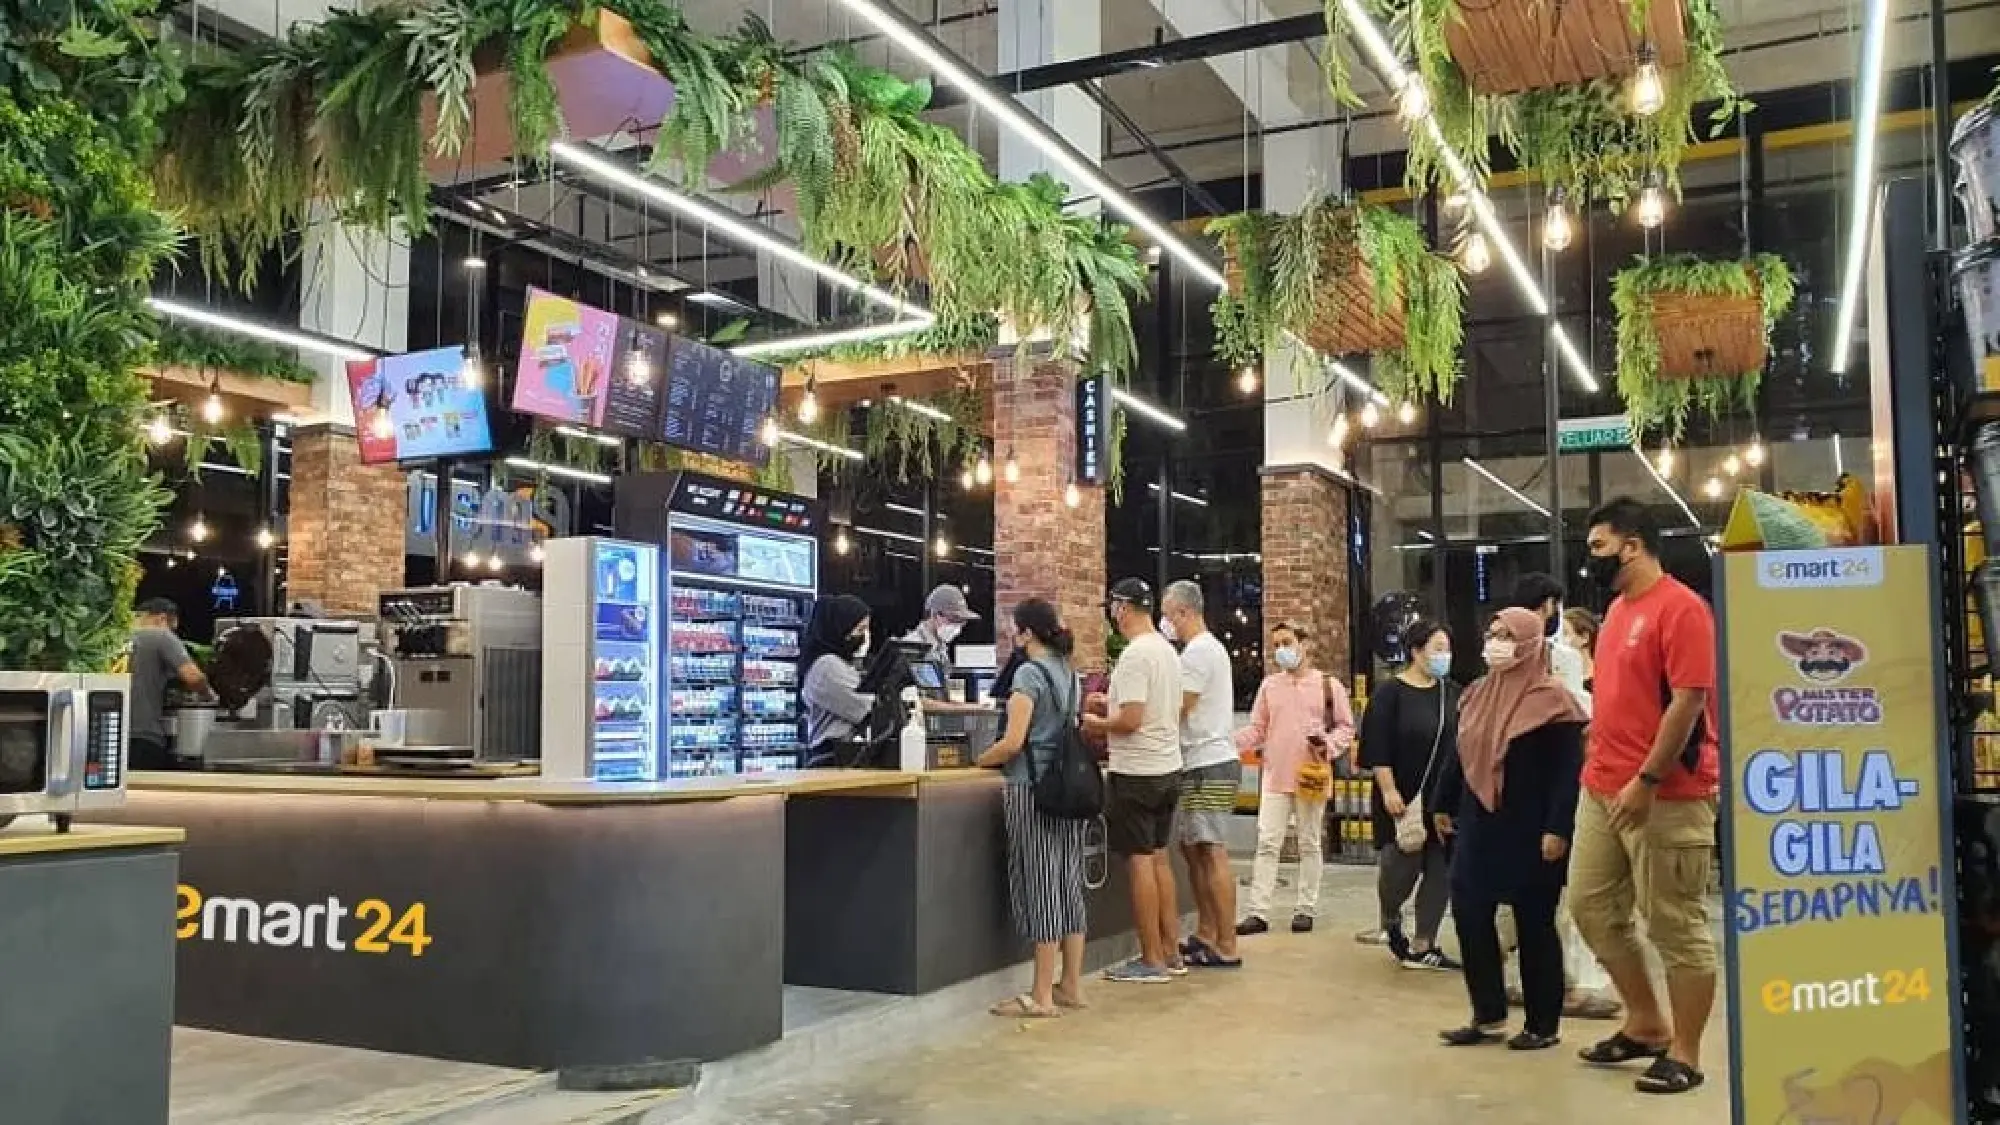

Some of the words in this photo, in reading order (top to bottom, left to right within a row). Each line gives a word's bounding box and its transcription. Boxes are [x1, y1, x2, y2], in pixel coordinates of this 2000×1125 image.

[1774, 687, 1881, 723] POTATO
[1744, 749, 1919, 814] GILA-
[1770, 818, 1885, 876] GILA
[1735, 865, 1939, 933] SEDAPNYA!
